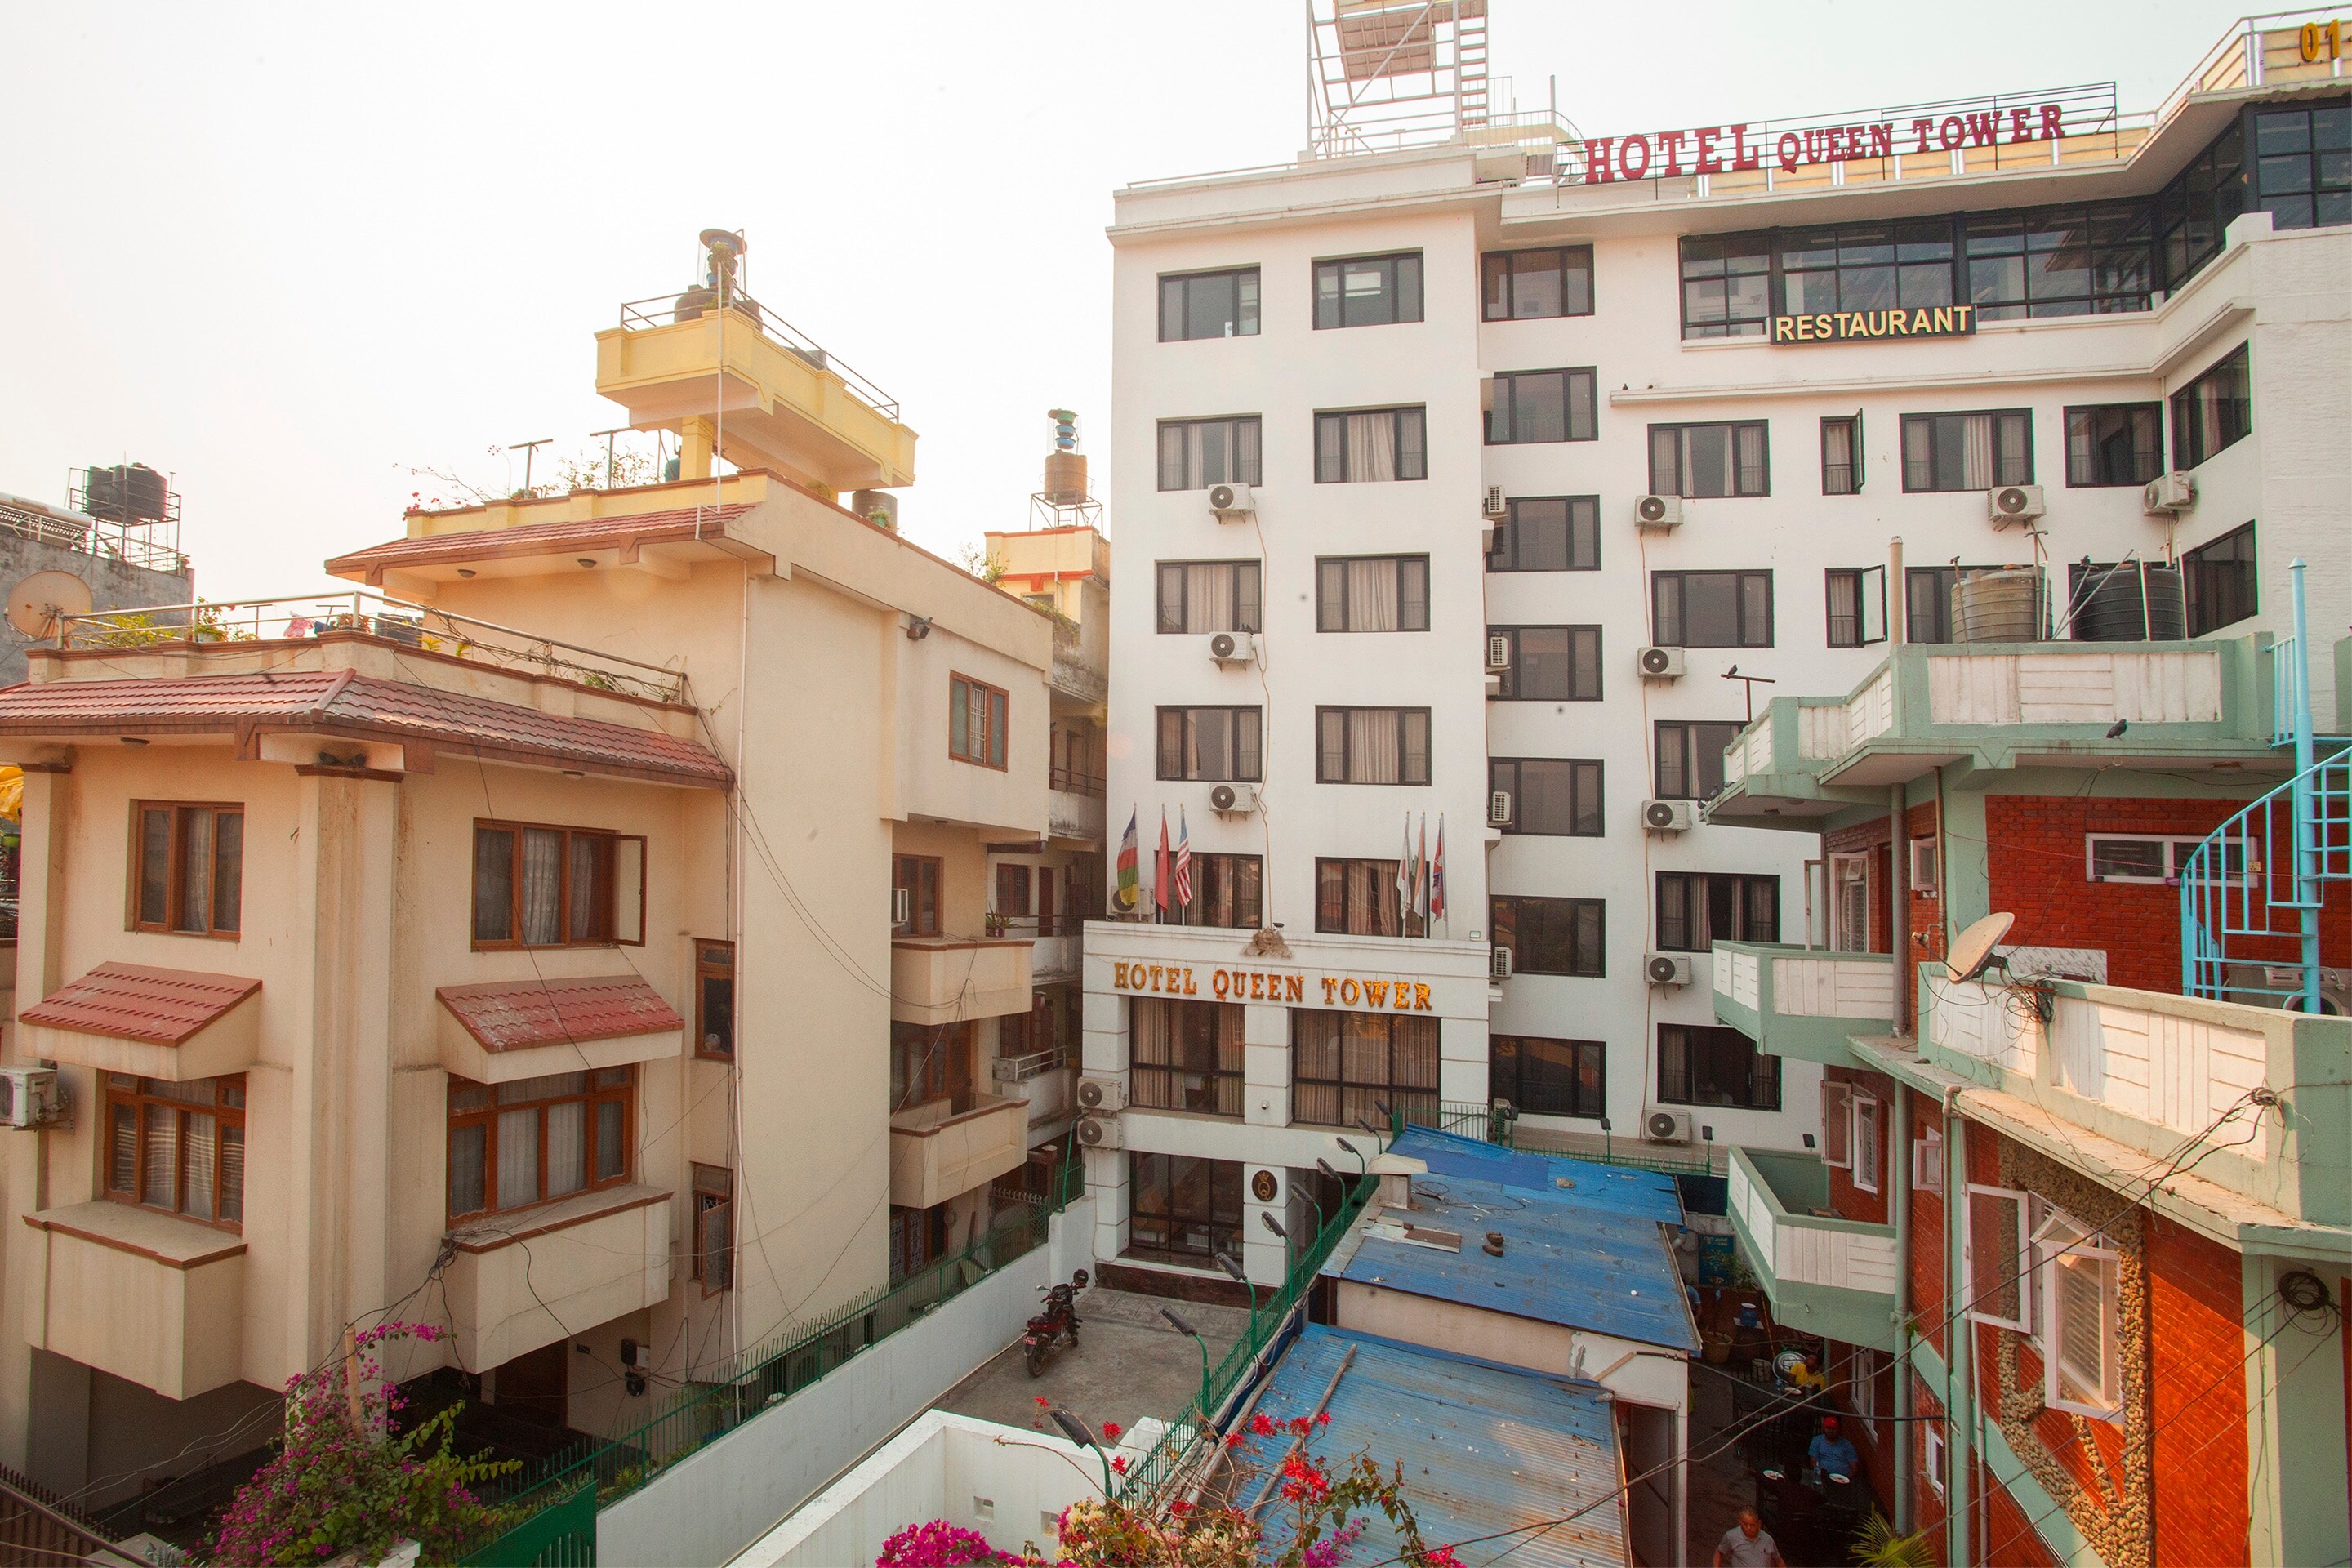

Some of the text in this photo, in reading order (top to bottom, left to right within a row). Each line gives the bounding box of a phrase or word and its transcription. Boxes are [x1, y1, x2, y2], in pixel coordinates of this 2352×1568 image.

[1584, 104, 2065, 185] HOTEL QUEEN TOWER
[1775, 305, 1972, 342] RESTAURANT
[1114, 962, 1433, 1011] HOTEL QUEEN TOWER
[1258, 1181, 1272, 1200] Q
